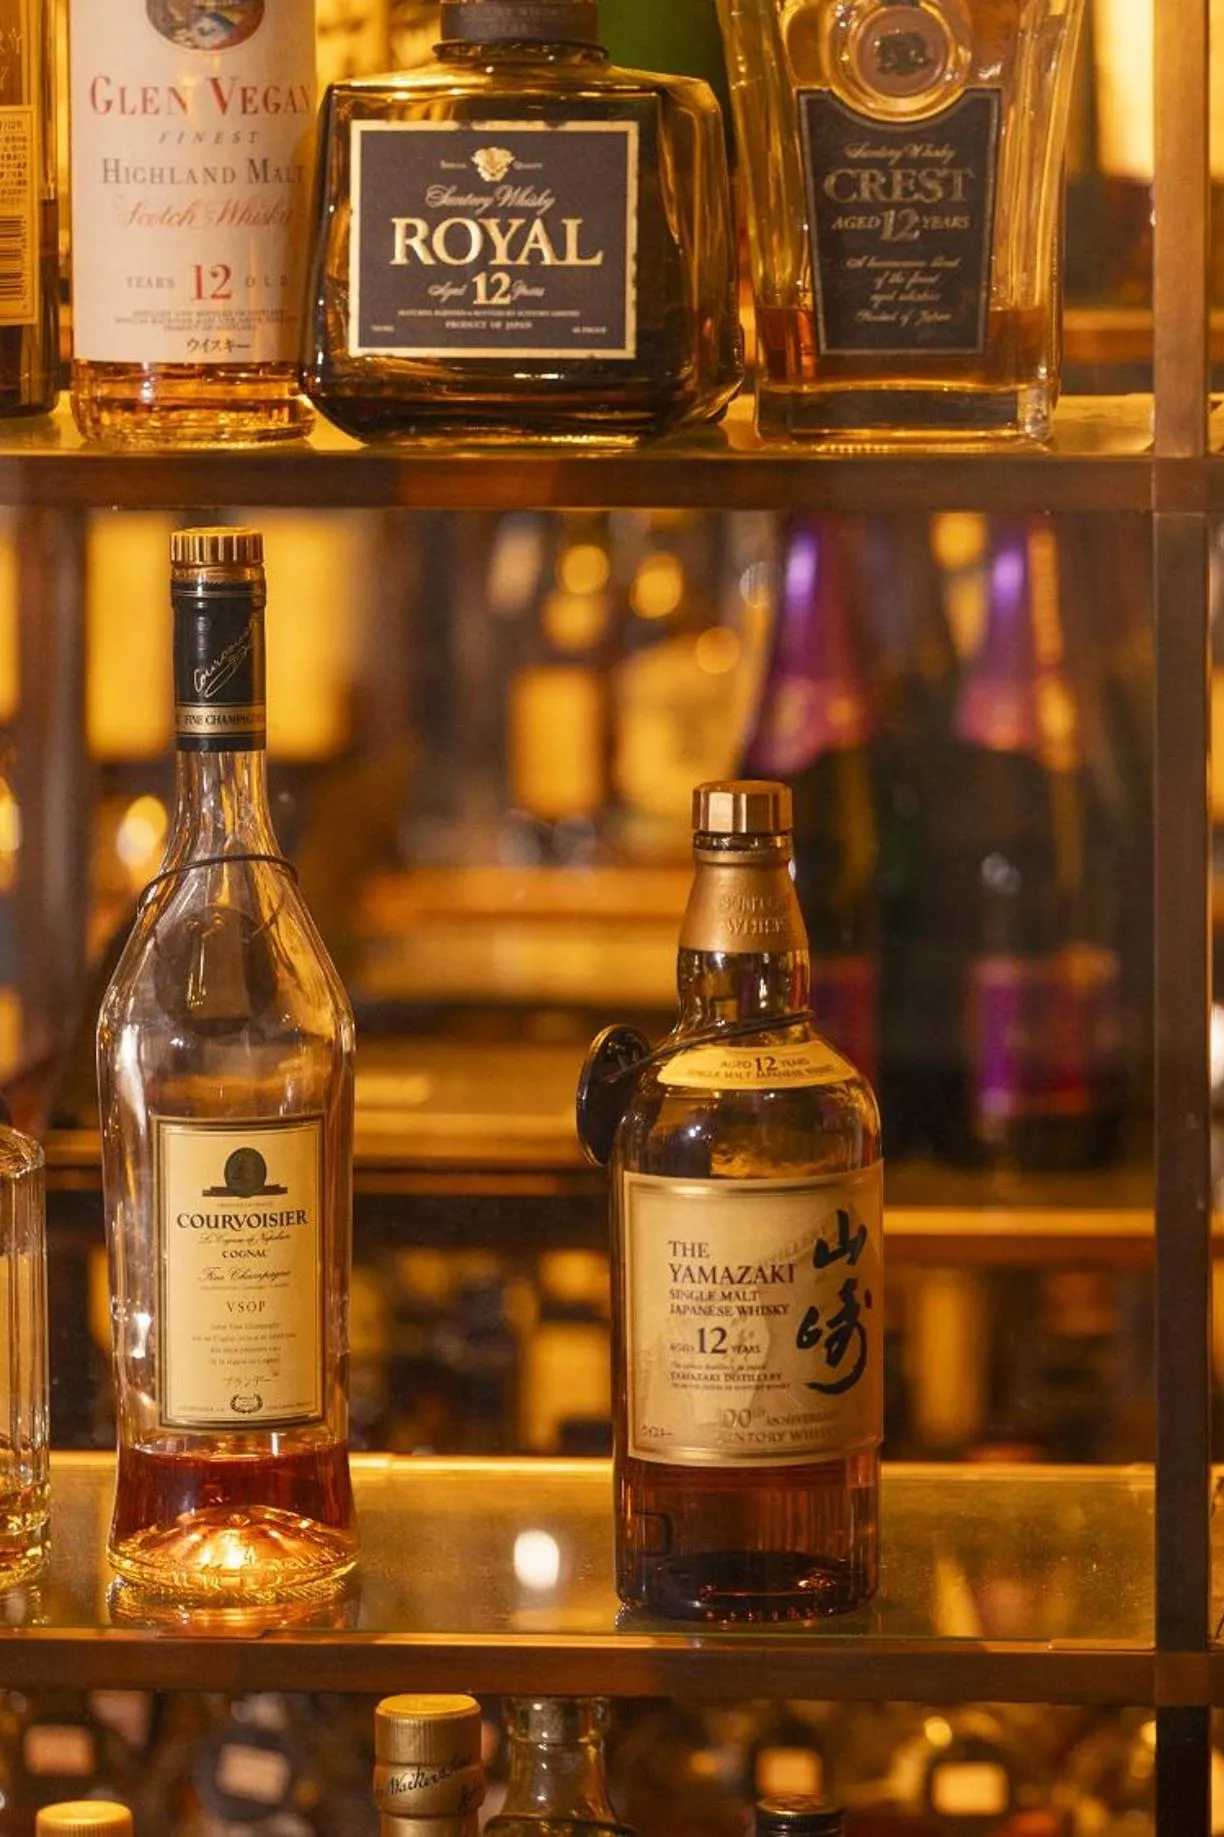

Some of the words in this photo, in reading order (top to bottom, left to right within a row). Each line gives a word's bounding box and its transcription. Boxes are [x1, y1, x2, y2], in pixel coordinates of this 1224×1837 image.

[89, 75, 190, 116] GLEN
[158, 130, 260, 145] FINEST
[101, 158, 237, 185] HIGHLAND
[823, 167, 977, 204] CREST
[831, 215, 881, 230] AGED
[878, 207, 921, 242] 12
[389, 217, 604, 266] ROYAL
[125, 276, 176, 289] YEARS
[189, 263, 232, 301] 12
[472, 271, 513, 305] 12
[186, 337, 251, 353] ウイスキー
[754, 1055, 779, 1073] 12
[176, 1208, 309, 1232] COURVOISIER
[221, 1248, 269, 1260] COGNAC
[668, 1240, 710, 1259] THE
[668, 1262, 798, 1286] YAMAZAKI
[669, 1288, 717, 1302] SINGLE
[720, 1289, 760, 1302] MALT
[669, 1303, 735, 1317] JAPANESE
[736, 1303, 790, 1317] WHISKY
[697, 1325, 728, 1354] 12
